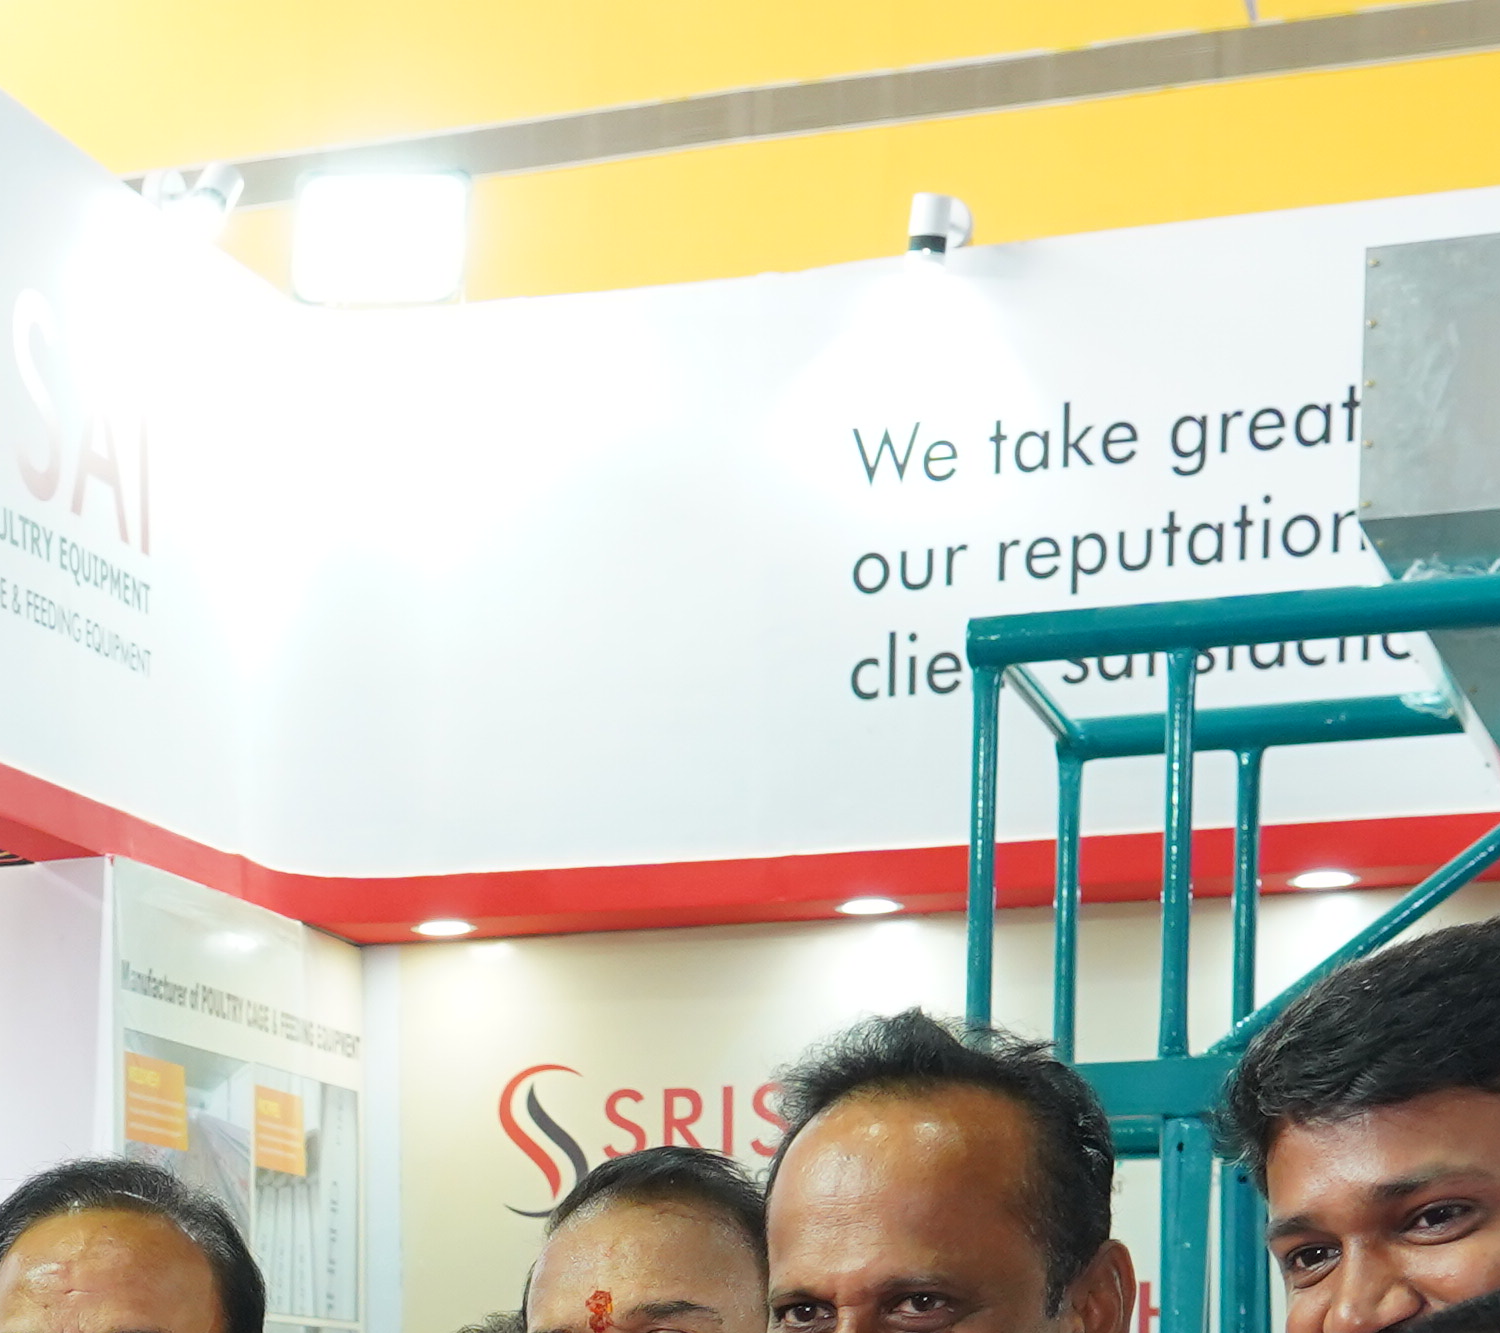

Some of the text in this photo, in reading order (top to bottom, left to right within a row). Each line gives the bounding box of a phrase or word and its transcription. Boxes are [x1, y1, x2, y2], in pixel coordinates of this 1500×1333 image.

[853, 385, 1361, 485] We take great
[59, 536, 151, 615] EQUIPMENT
[851, 540, 969, 595] our
[11, 583, 22, 615] &
[26, 589, 82, 643] FEEDING
[85, 618, 151, 677] EQUIPMENT
[851, 632, 1006, 700] clie
[201, 984, 243, 1024] POULTRY
[246, 999, 269, 1033] CAGE
